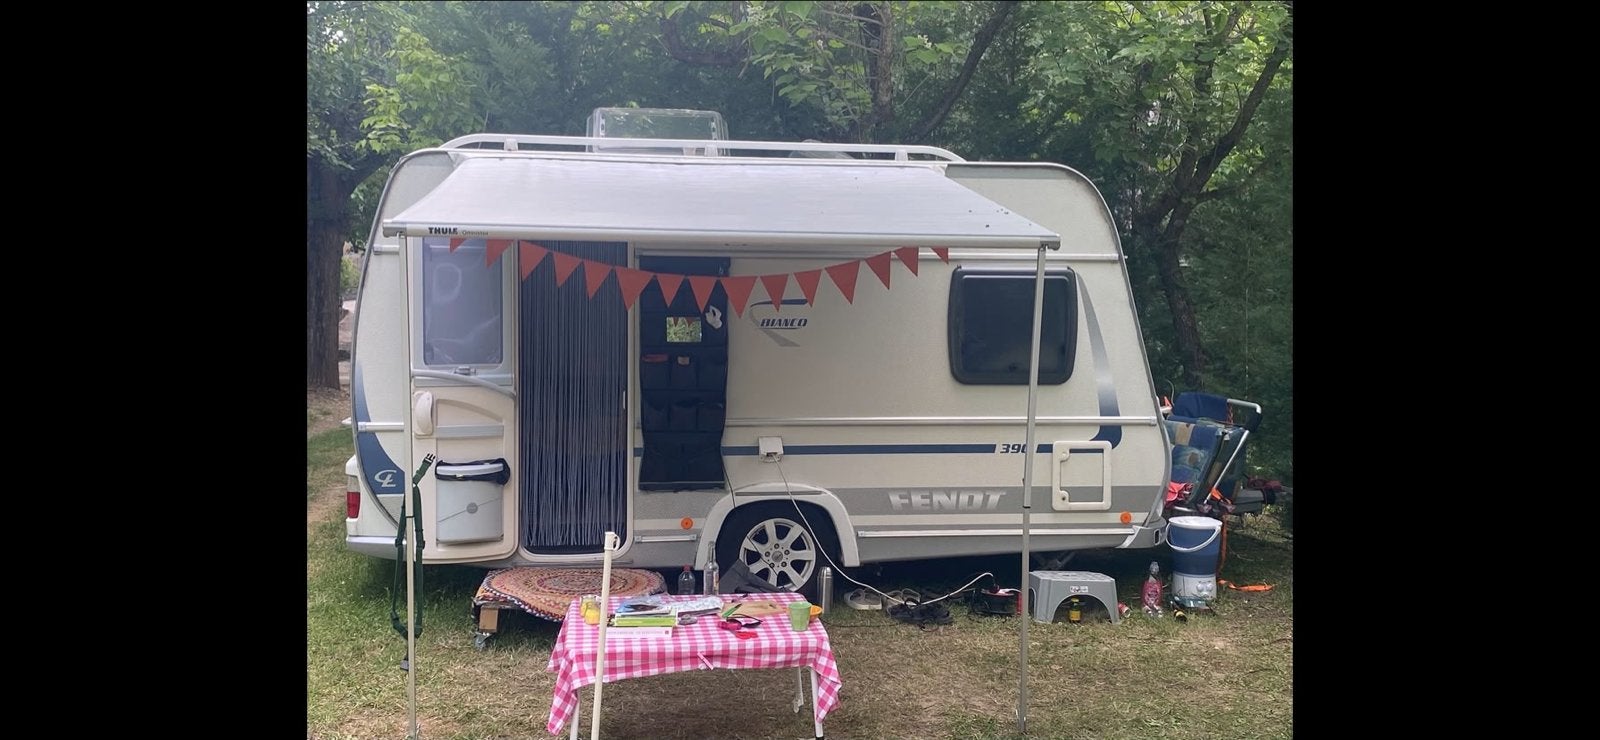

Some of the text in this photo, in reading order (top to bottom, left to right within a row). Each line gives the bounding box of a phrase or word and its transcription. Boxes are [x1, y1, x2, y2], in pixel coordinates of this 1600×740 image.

[428, 227, 458, 235] THULE
[760, 318, 808, 327] BIANCO
[888, 490, 1007, 510] FENDT
